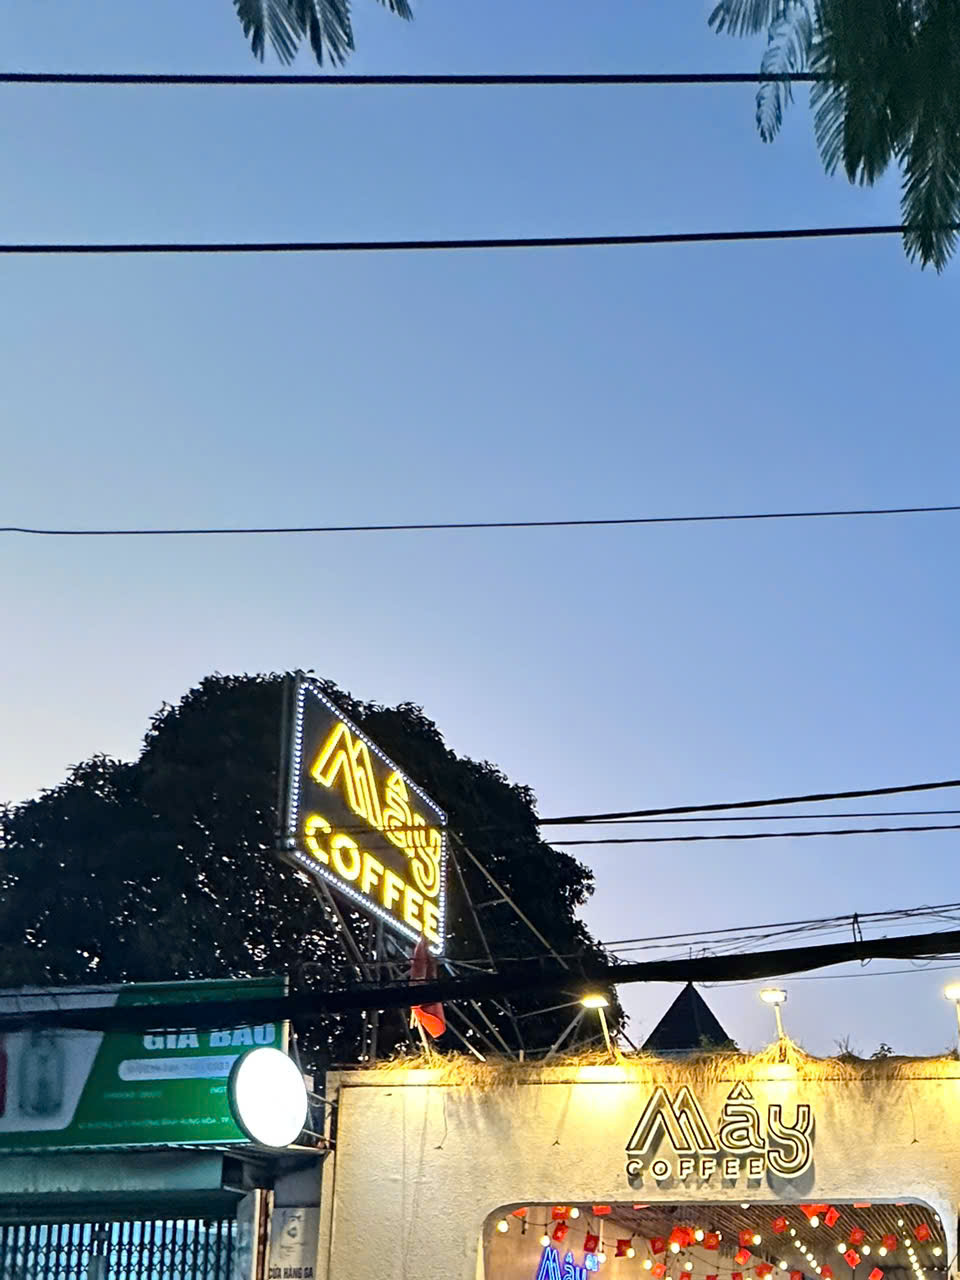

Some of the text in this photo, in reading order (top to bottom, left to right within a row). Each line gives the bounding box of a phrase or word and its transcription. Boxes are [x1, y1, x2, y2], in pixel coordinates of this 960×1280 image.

[311, 721, 443, 898] Mây
[304, 814, 443, 947] COFFEE
[625, 1080, 811, 1178] Mây
[625, 1159, 766, 1177] COFFEE
